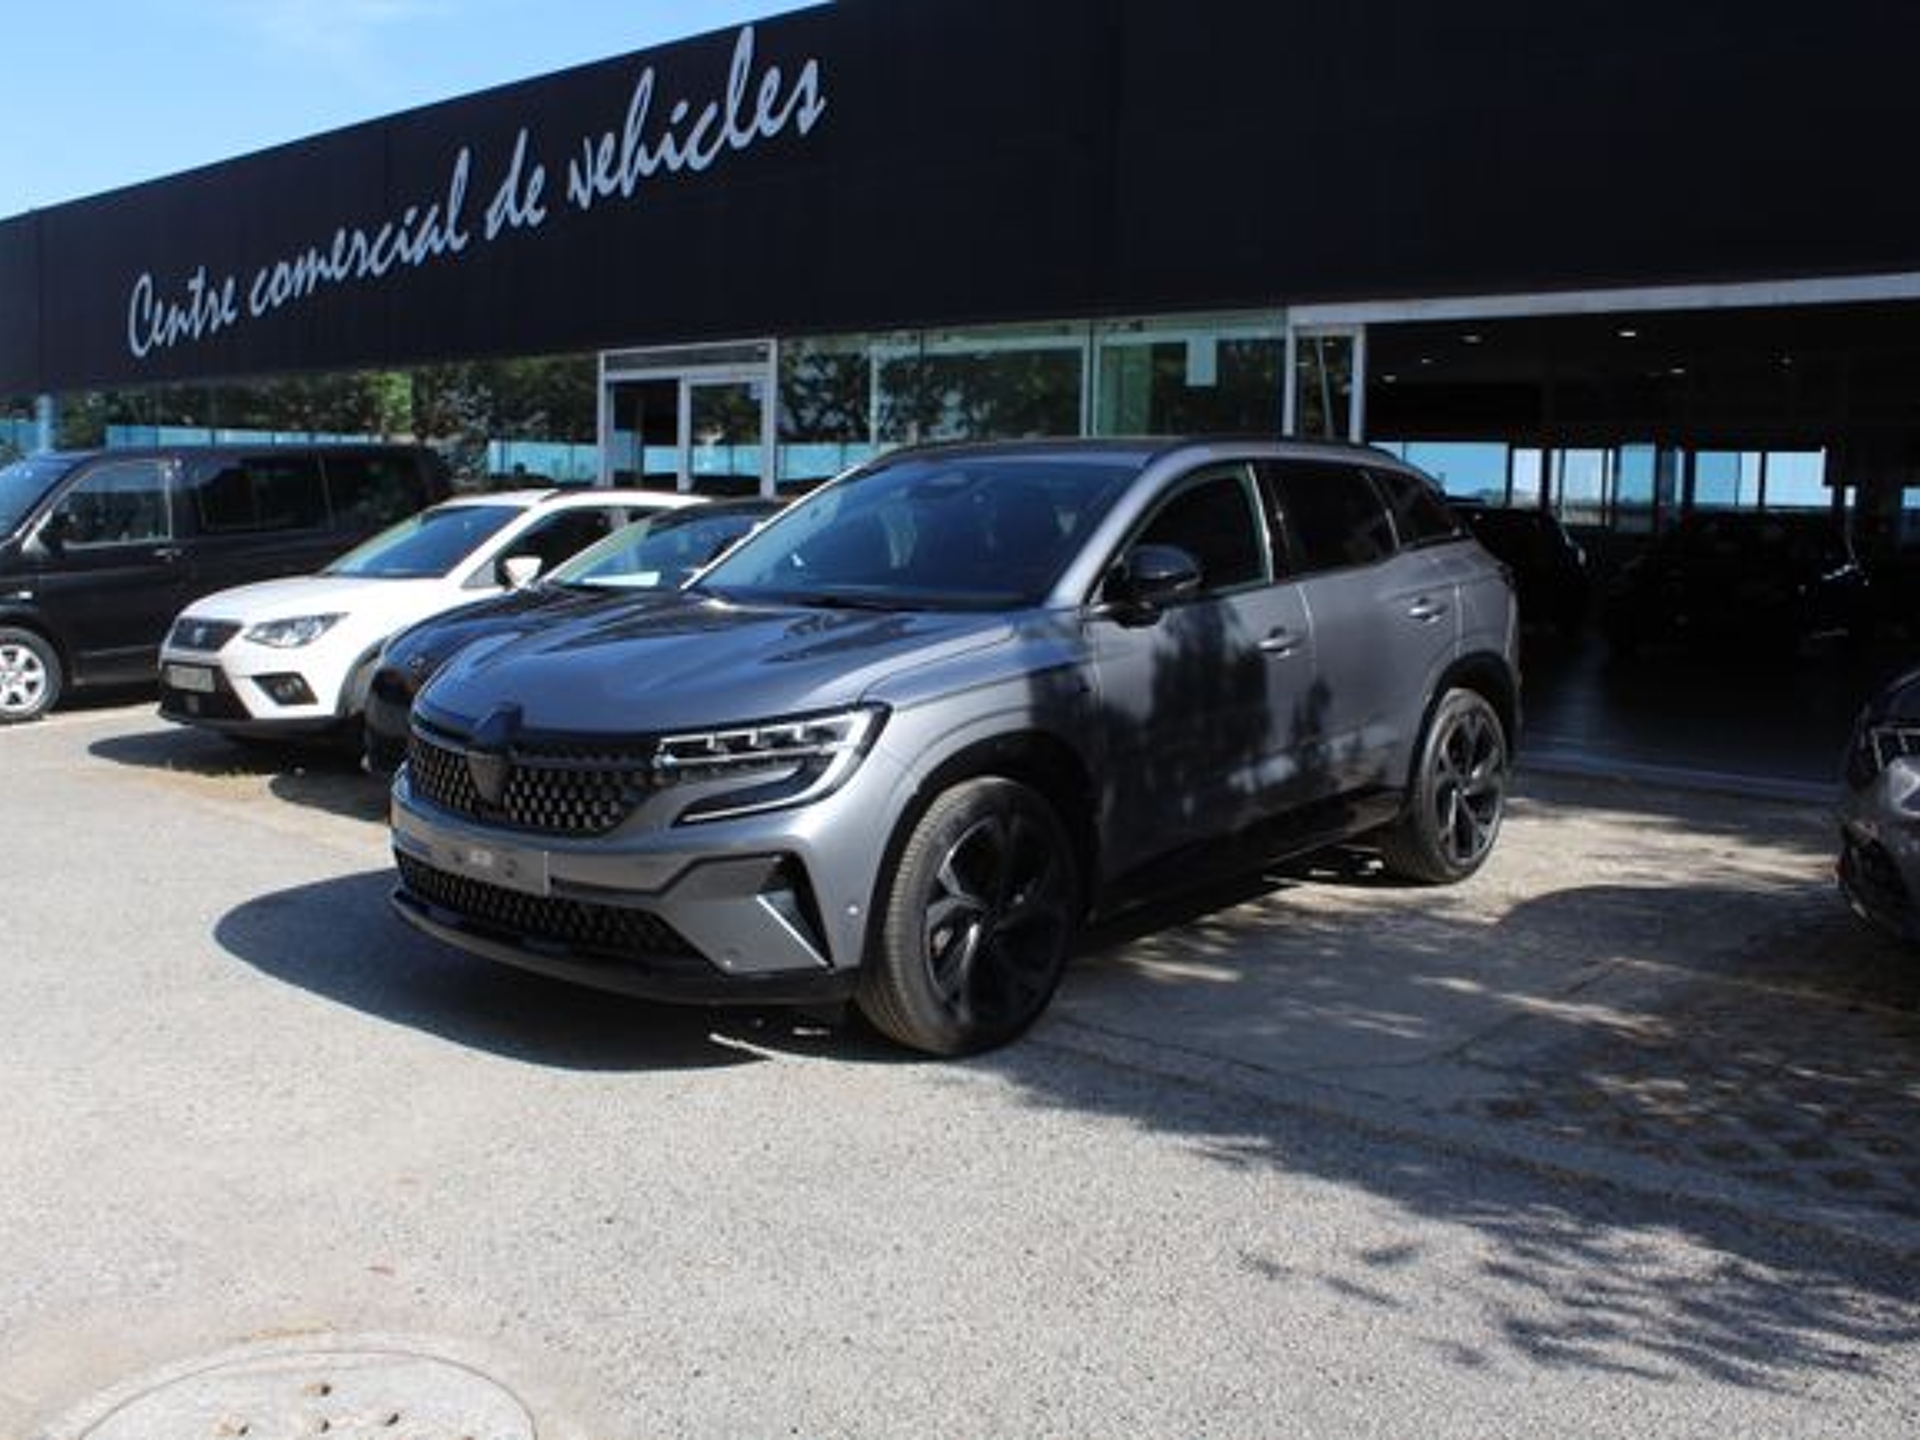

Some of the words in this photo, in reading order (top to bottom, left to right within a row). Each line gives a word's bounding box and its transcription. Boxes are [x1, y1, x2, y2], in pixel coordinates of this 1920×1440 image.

[128, 267, 237, 358] Centre
[249, 147, 470, 317] comercial
[485, 129, 546, 241] de
[567, 26, 826, 210] vehicles
